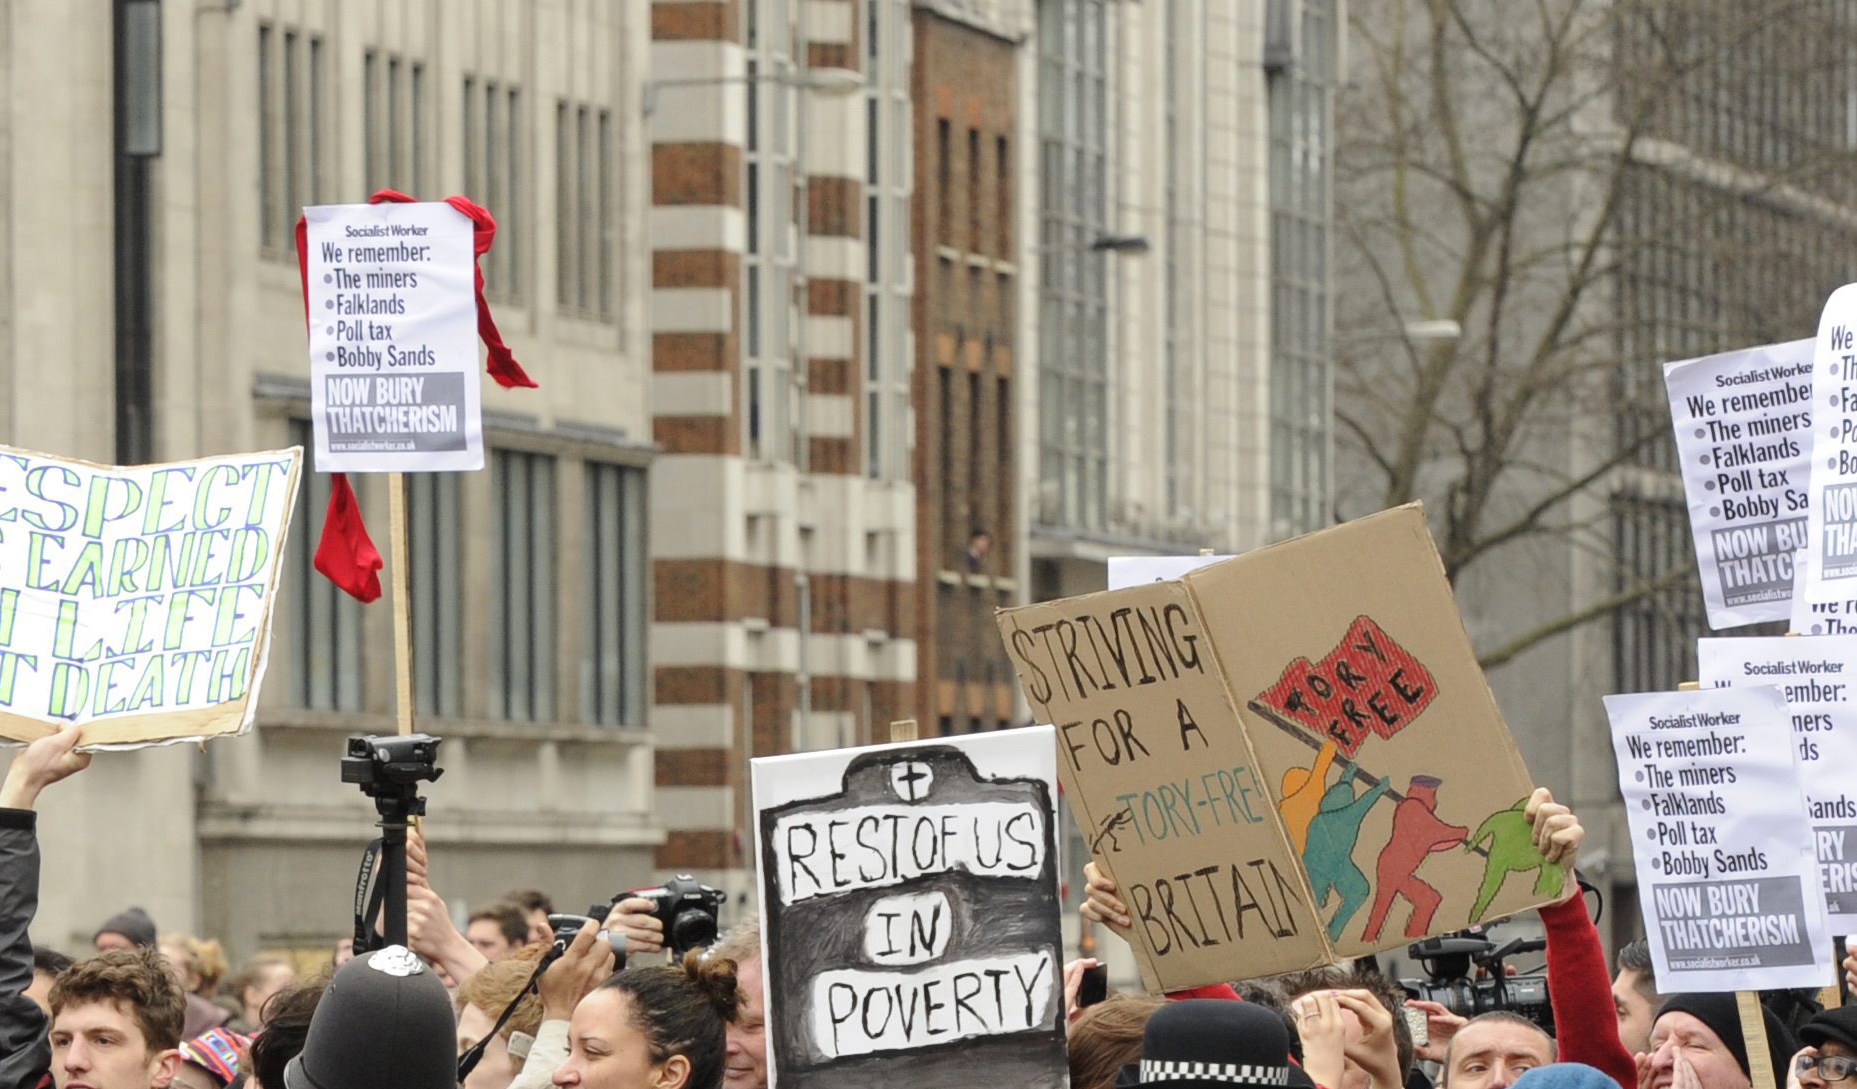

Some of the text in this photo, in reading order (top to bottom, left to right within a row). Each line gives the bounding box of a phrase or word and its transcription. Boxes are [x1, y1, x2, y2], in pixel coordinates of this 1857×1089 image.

[345, 225, 429, 238] Socialist Worker
[321, 241, 431, 263] We remember:
[333, 267, 417, 289] The miners
[336, 293, 405, 316] Falklands
[336, 320, 392, 342] Poll tax
[1831, 325, 1853, 351] We
[336, 344, 435, 371] Bobby Sands
[1842, 355, 1857, 381] Th
[1716, 363, 1814, 388] Socialist Worke
[327, 377, 425, 405] NOW BURY
[327, 405, 457, 434] THATCHERISM
[1686, 394, 1716, 419] We
[1706, 411, 1812, 443] The miners
[1712, 437, 1801, 469] Falklands
[1717, 468, 1790, 495] Poll tax
[1722, 494, 1779, 521] Bobby
[1825, 487, 1857, 522] NO
[1715, 526, 1768, 561] NOW
[1775, 520, 1808, 552] BU
[25, 528, 269, 599] EARNED
[52, 583, 265, 663] LIFE
[1010, 602, 1204, 707] STRIVING
[1744, 660, 1844, 675] Socialist Worker
[48, 647, 250, 720] DEATH
[1284, 630, 1387, 716] TORY
[1328, 667, 1425, 747] FREE
[1649, 711, 1741, 730] Socialist Worker
[1061, 698, 1209, 772] FOR A
[1792, 713, 1833, 733] ners
[1626, 731, 1746, 760] We remember:
[1644, 762, 1737, 788] The miners
[1650, 790, 1726, 817] Falklands
[974, 811, 1038, 871] US
[1657, 820, 1718, 846] Poll tax
[1662, 846, 1768, 879] Bobby Sands
[1656, 883, 1760, 919] NOW BURY
[876, 904, 941, 957] IN
[1661, 914, 1801, 951] THATCHERISM
[1669, 956, 1761, 970] www.socialistworker.co.uk
[828, 958, 1048, 1056] POVERTY
